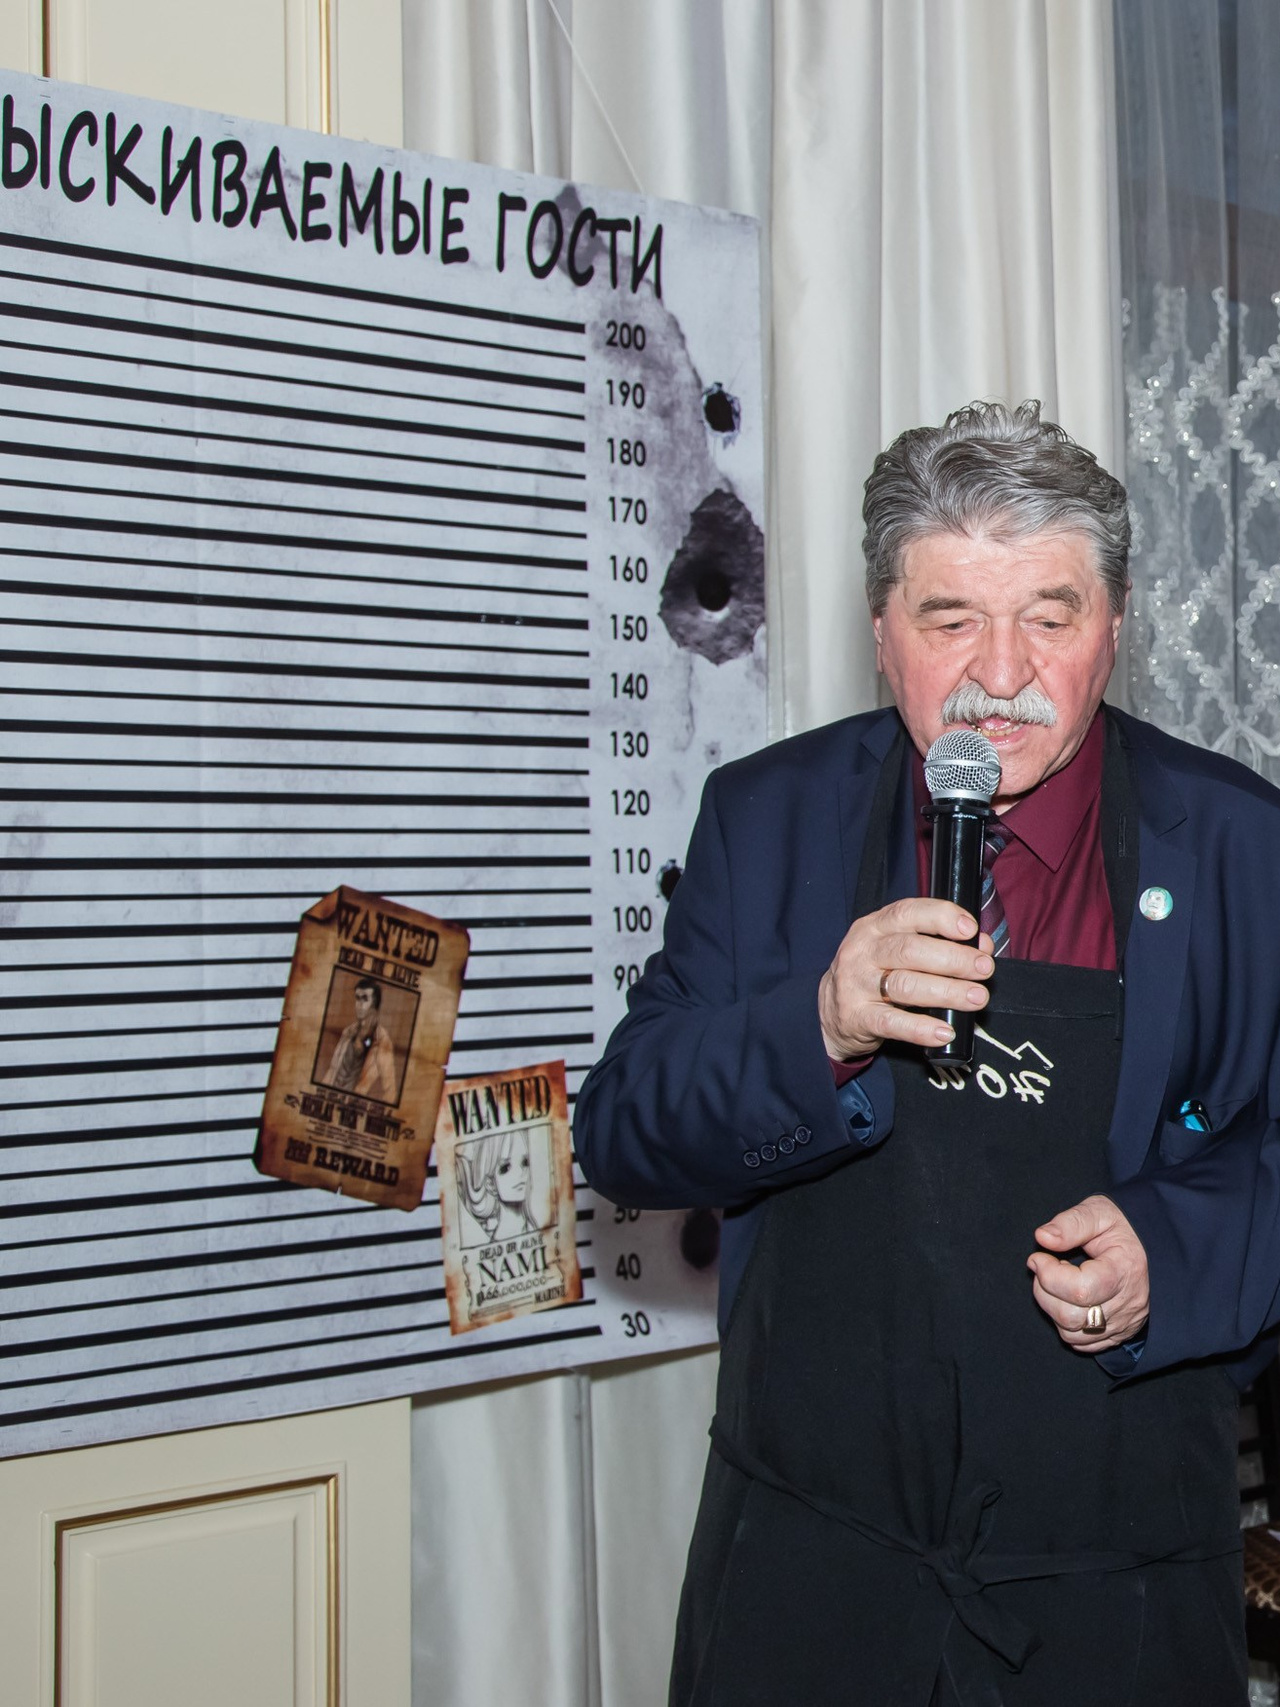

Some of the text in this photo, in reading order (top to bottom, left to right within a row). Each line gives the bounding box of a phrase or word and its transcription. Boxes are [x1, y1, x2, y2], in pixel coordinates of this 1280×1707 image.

[1, 94, 663, 300] ЫСКИВАЕМЫЕ ГОСТИ
[606, 320, 646, 351] 200
[606, 379, 645, 409] 190
[607, 438, 646, 467] 180
[608, 496, 647, 525] 170
[610, 555, 648, 583] 160
[610, 614, 648, 642] 150
[610, 672, 648, 700] 140
[610, 731, 649, 758] 130
[611, 789, 650, 816] 120
[612, 848, 651, 874] 110
[613, 905, 652, 933] 100
[338, 902, 439, 968] WANTED
[614, 964, 640, 991] 90
[448, 1075, 551, 1137] WANTED
[313, 1146, 399, 1187] REWARD
[480, 1245, 503, 1260] DEAD
[521, 1233, 544, 1250] ALIVE
[477, 1245, 549, 1287] NAMI
[616, 1253, 641, 1280] 40
[621, 1310, 650, 1338] 30
